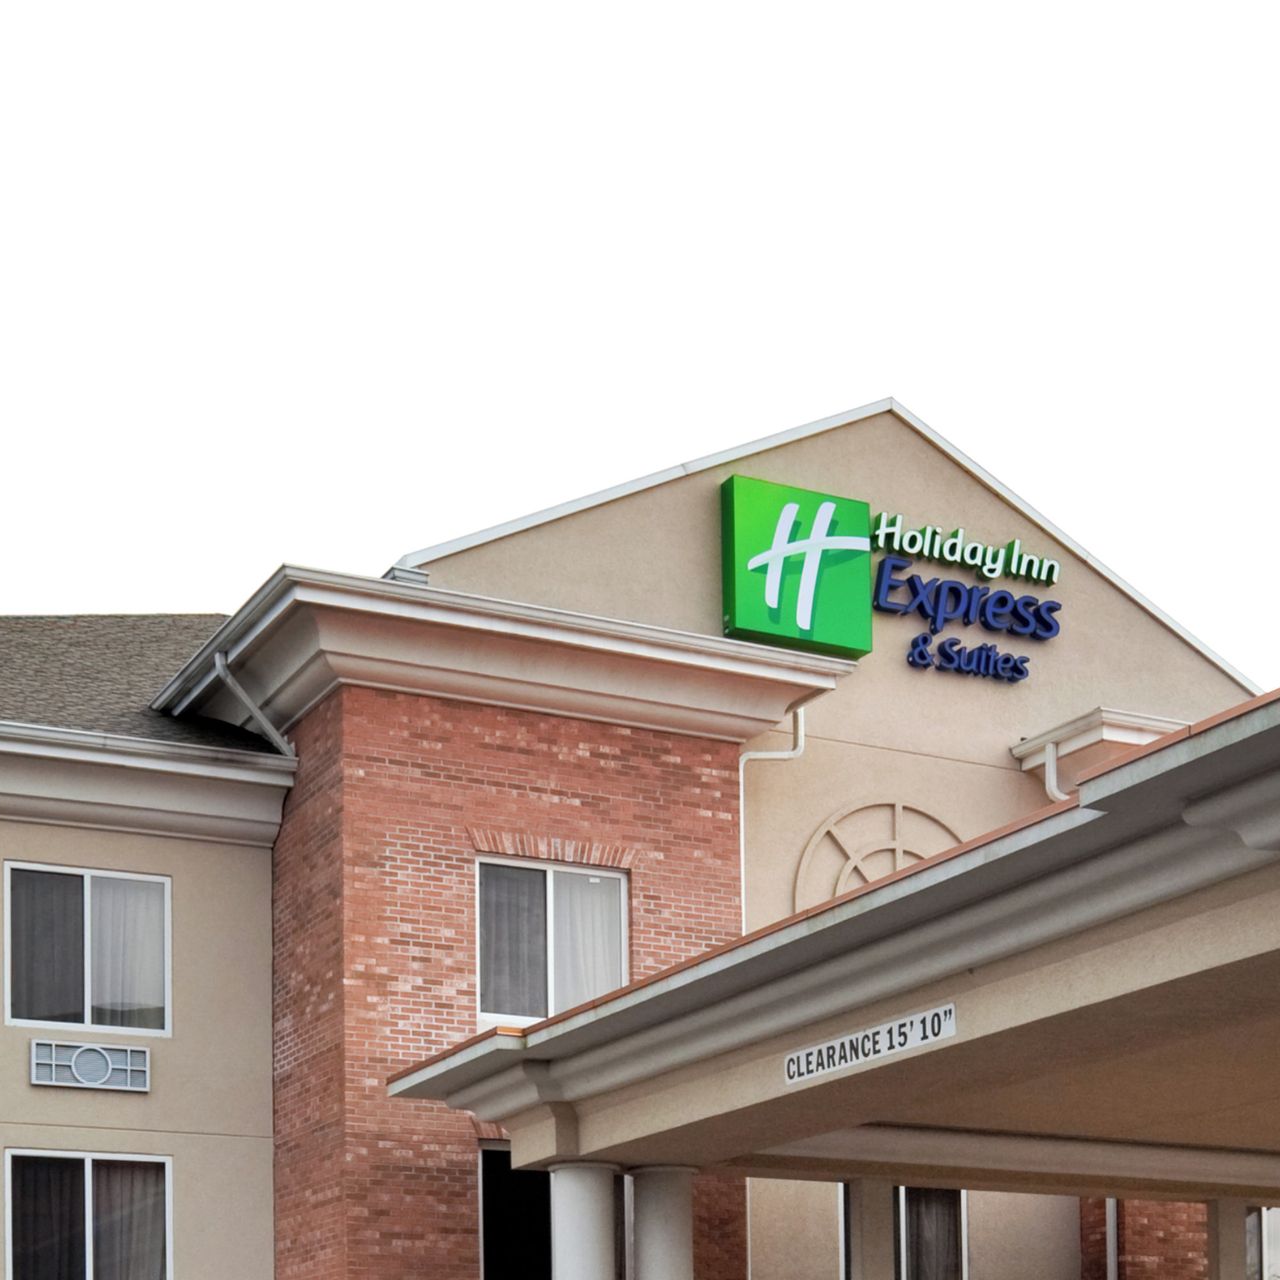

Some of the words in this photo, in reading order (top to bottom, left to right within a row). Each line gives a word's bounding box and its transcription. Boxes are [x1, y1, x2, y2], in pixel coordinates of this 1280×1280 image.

[873, 511, 1007, 579] Holiday
[1008, 539, 1062, 586] Inn
[873, 555, 1062, 641] Express
[907, 632, 936, 670] &
[936, 637, 1030, 683] Suites
[786, 1030, 882, 1080] CLEARANCE
[886, 1020, 914, 1051] 15'
